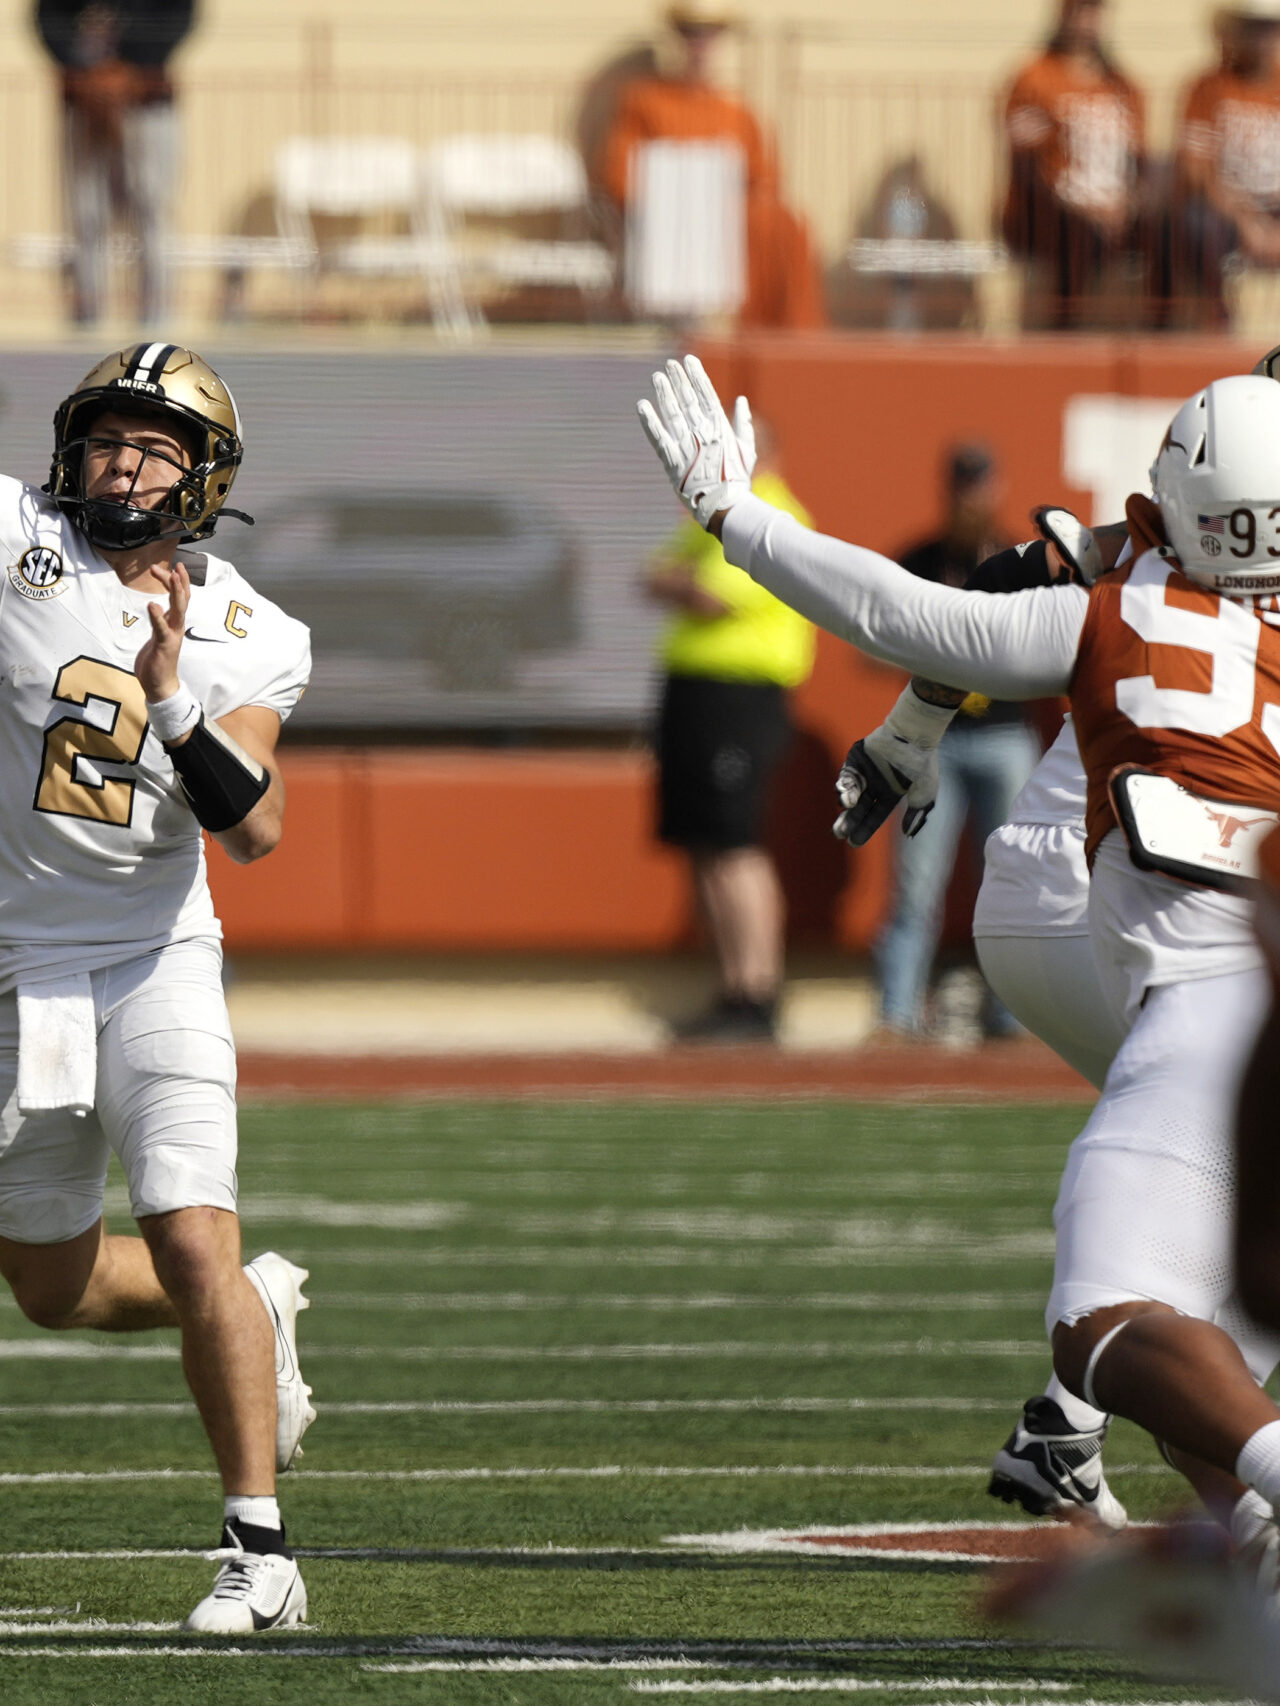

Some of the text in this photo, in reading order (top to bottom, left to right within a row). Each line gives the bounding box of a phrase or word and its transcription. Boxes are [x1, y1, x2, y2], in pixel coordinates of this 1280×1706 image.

[22, 548, 61, 586] SEC
[1215, 575, 1280, 590] LONGHO
[11, 574, 57, 598] GRADUATE
[122, 610, 139, 628] V
[224, 600, 253, 639] C
[33, 655, 149, 828] 2
